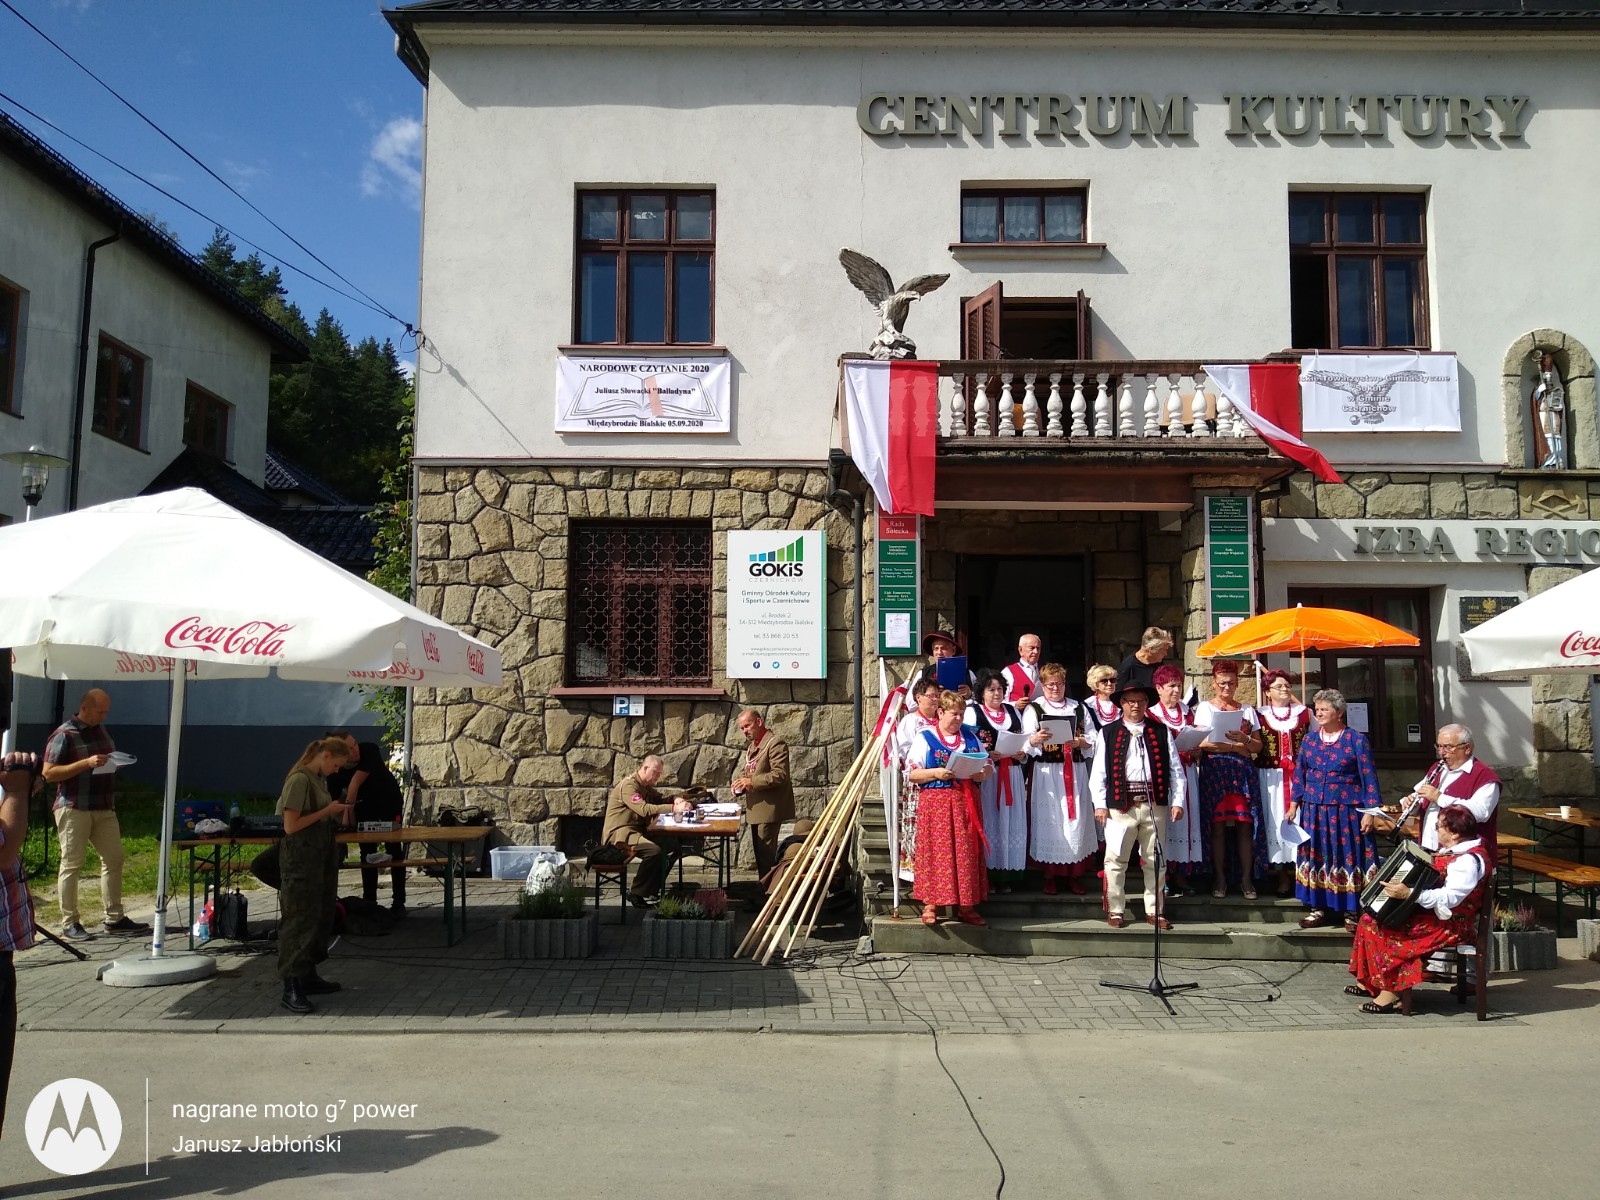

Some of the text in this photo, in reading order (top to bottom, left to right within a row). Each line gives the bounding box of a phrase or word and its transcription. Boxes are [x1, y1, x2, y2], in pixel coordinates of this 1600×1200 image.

[856, 92, 1530, 140] CENTRUM KULTURY
[579, 364, 710, 373] NARODOWE CZYTANIE 2020
[1385, 374, 1451, 383] Gimnastyczne
[594, 387, 619, 395] Juliusz
[652, 387, 696, 396] "Balladyna"
[1357, 394, 1391, 402] Gminie
[587, 419, 704, 428] Międzybrodzie Bialskie 05.09.2020
[1353, 526, 1600, 557] IZBA REGIO
[749, 562, 804, 577] GOKiS
[165, 616, 296, 656] Coca-Cola
[615, 696, 629, 714] P
